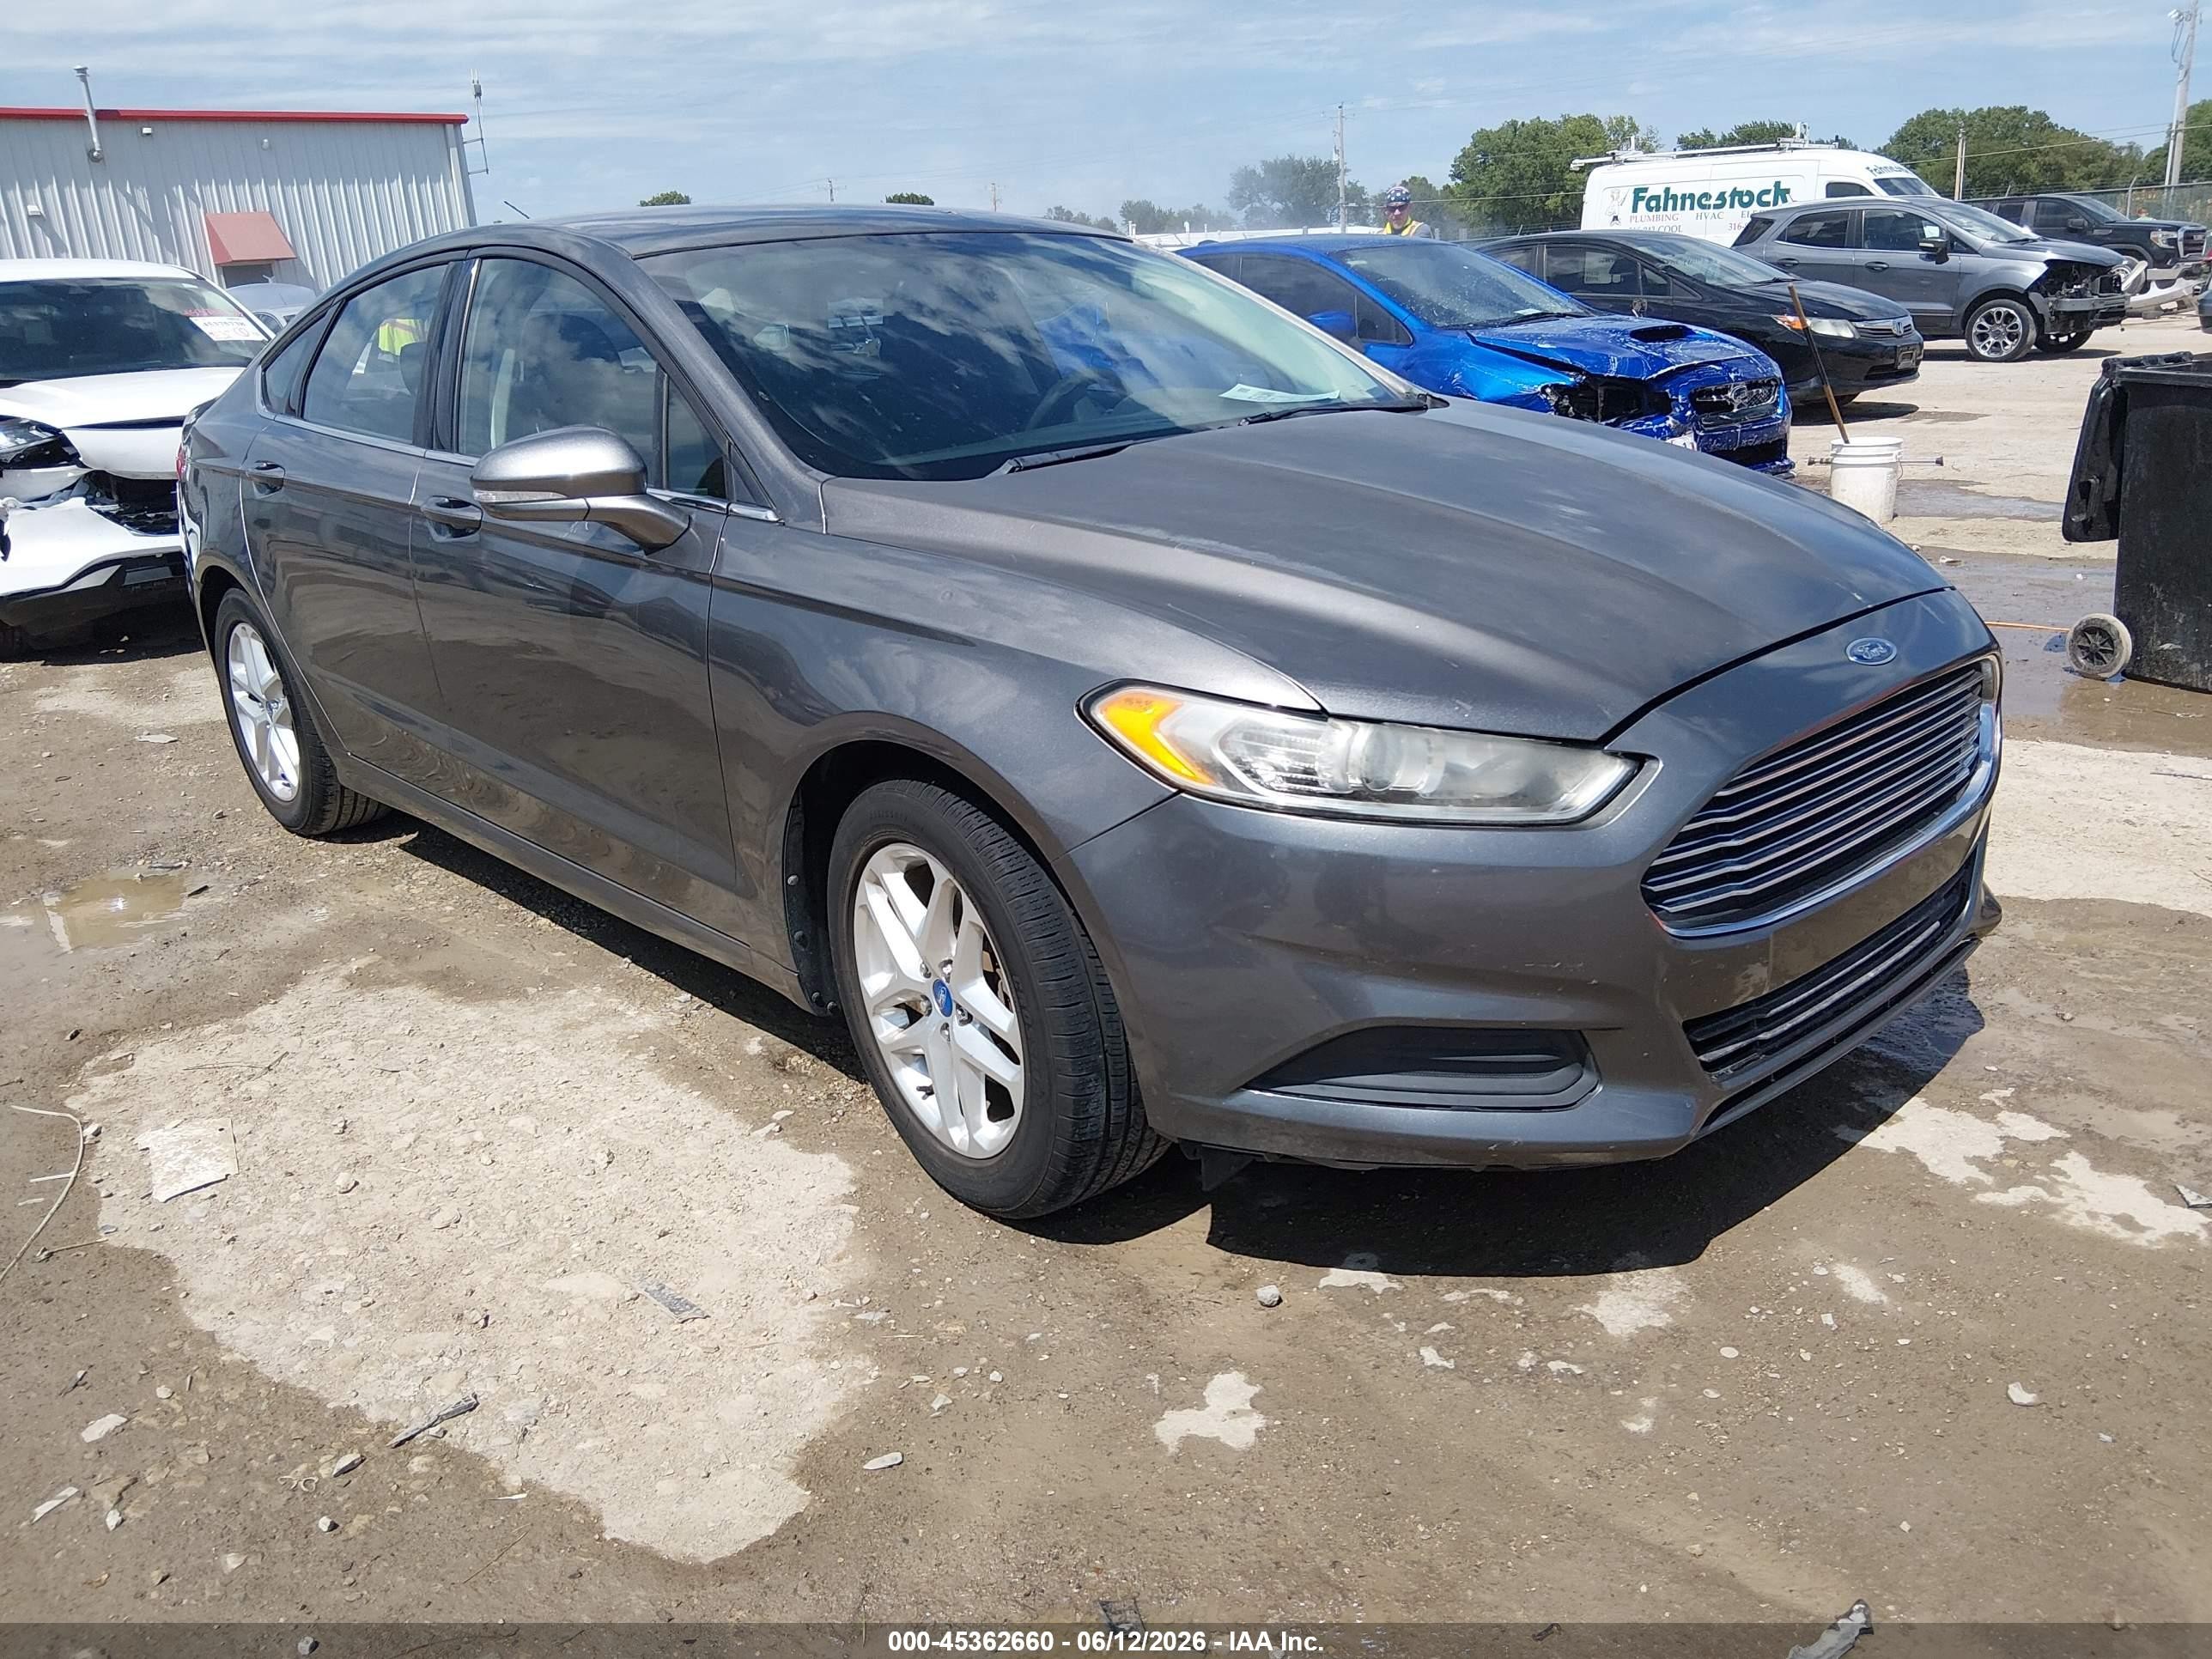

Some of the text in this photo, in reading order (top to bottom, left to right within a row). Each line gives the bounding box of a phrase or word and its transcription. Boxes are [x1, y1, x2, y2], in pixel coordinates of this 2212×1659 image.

[1632, 180, 1791, 214] Fahnestock
[1630, 211, 1724, 223] PLUMBING HVAC
